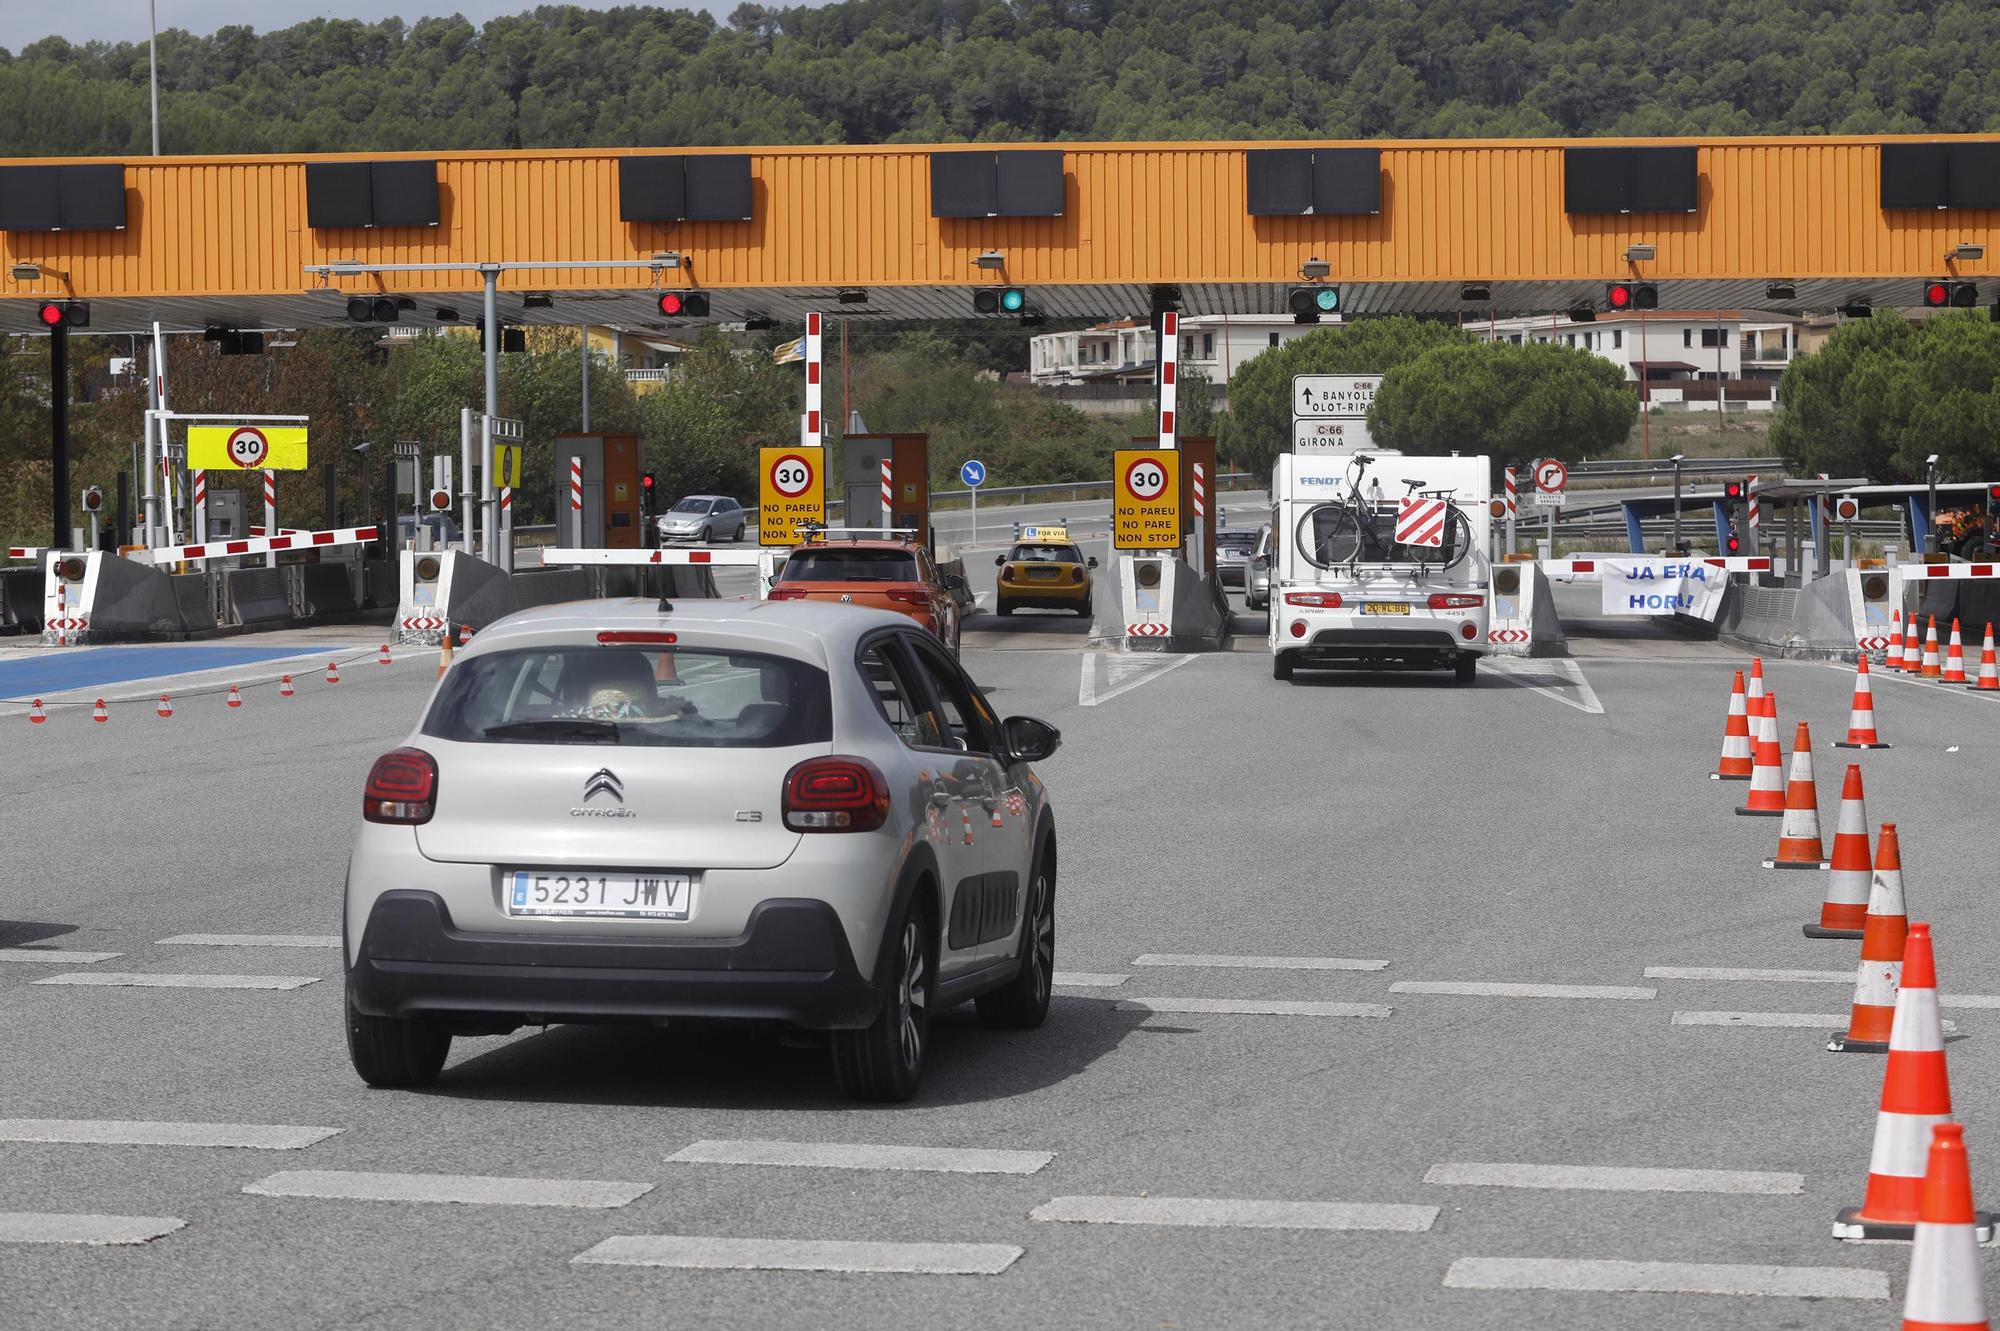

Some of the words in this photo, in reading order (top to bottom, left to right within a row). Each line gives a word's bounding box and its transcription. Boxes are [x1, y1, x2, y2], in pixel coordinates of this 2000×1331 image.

[1323, 391, 1375, 400] BANYOLE
[1312, 402, 1373, 412] OLOT-RIPO
[1299, 437, 1344, 447] GIRONA
[235, 440, 260, 455] 30
[779, 468, 805, 484] 30
[1134, 472, 1160, 487] 30
[1299, 477, 1343, 485] FENDT
[763, 504, 780, 513] NO
[785, 504, 820, 513] PAREU
[1118, 507, 1135, 516] NO
[1140, 507, 1176, 516] PAREU
[767, 517, 784, 526] NO
[1122, 520, 1139, 529] NO
[1144, 520, 1172, 529] PARE
[763, 530, 787, 539] NON
[793, 530, 822, 539] STP
[1118, 533, 1142, 542] NON
[1148, 533, 1177, 542] STOP
[1625, 565, 1655, 580] JA
[1663, 561, 1706, 582] ERA
[735, 810, 763, 823] C3
[534, 876, 608, 905] 5231
[622, 878, 681, 907] JWV
